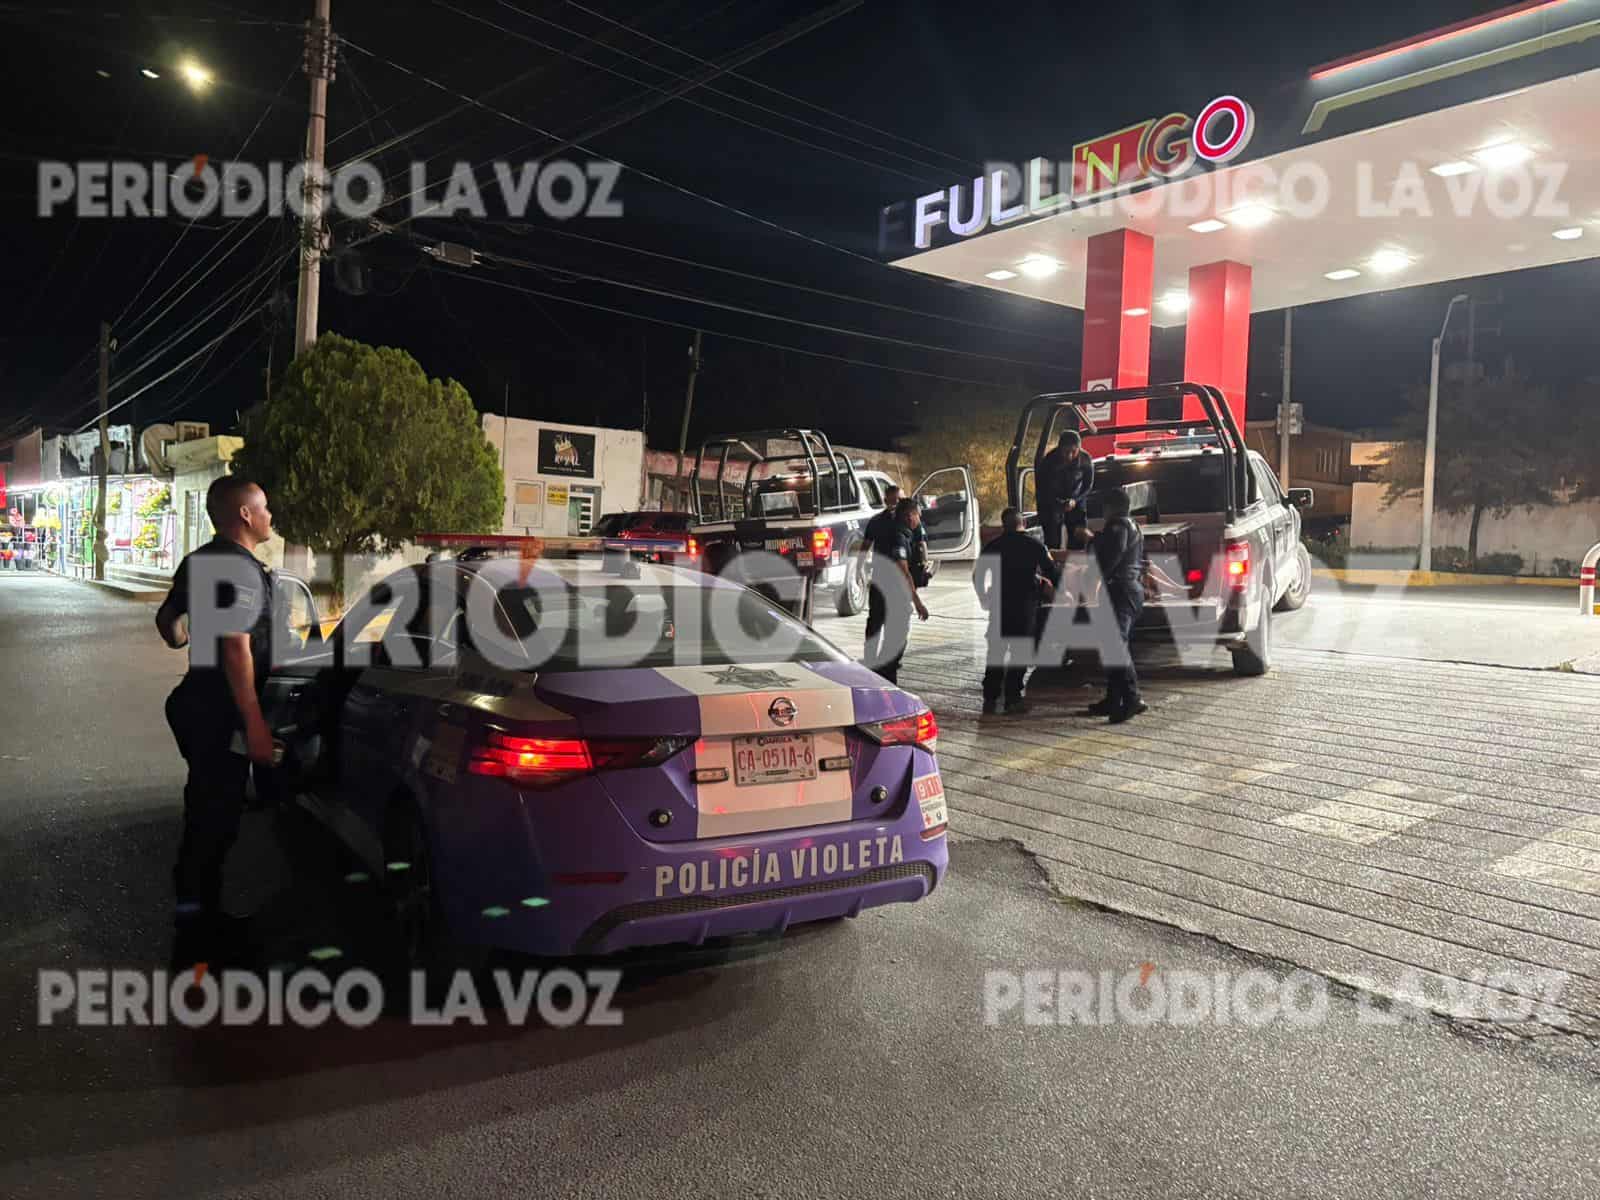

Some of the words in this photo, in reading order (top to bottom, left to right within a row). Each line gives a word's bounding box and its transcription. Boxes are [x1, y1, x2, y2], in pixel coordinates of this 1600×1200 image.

[914, 157, 1069, 249] FULL
[1143, 95, 1254, 178] GO
[738, 746, 813, 770] CA-051A-6
[655, 849, 782, 897] POLICÍA
[791, 835, 905, 880] VIOLETA
